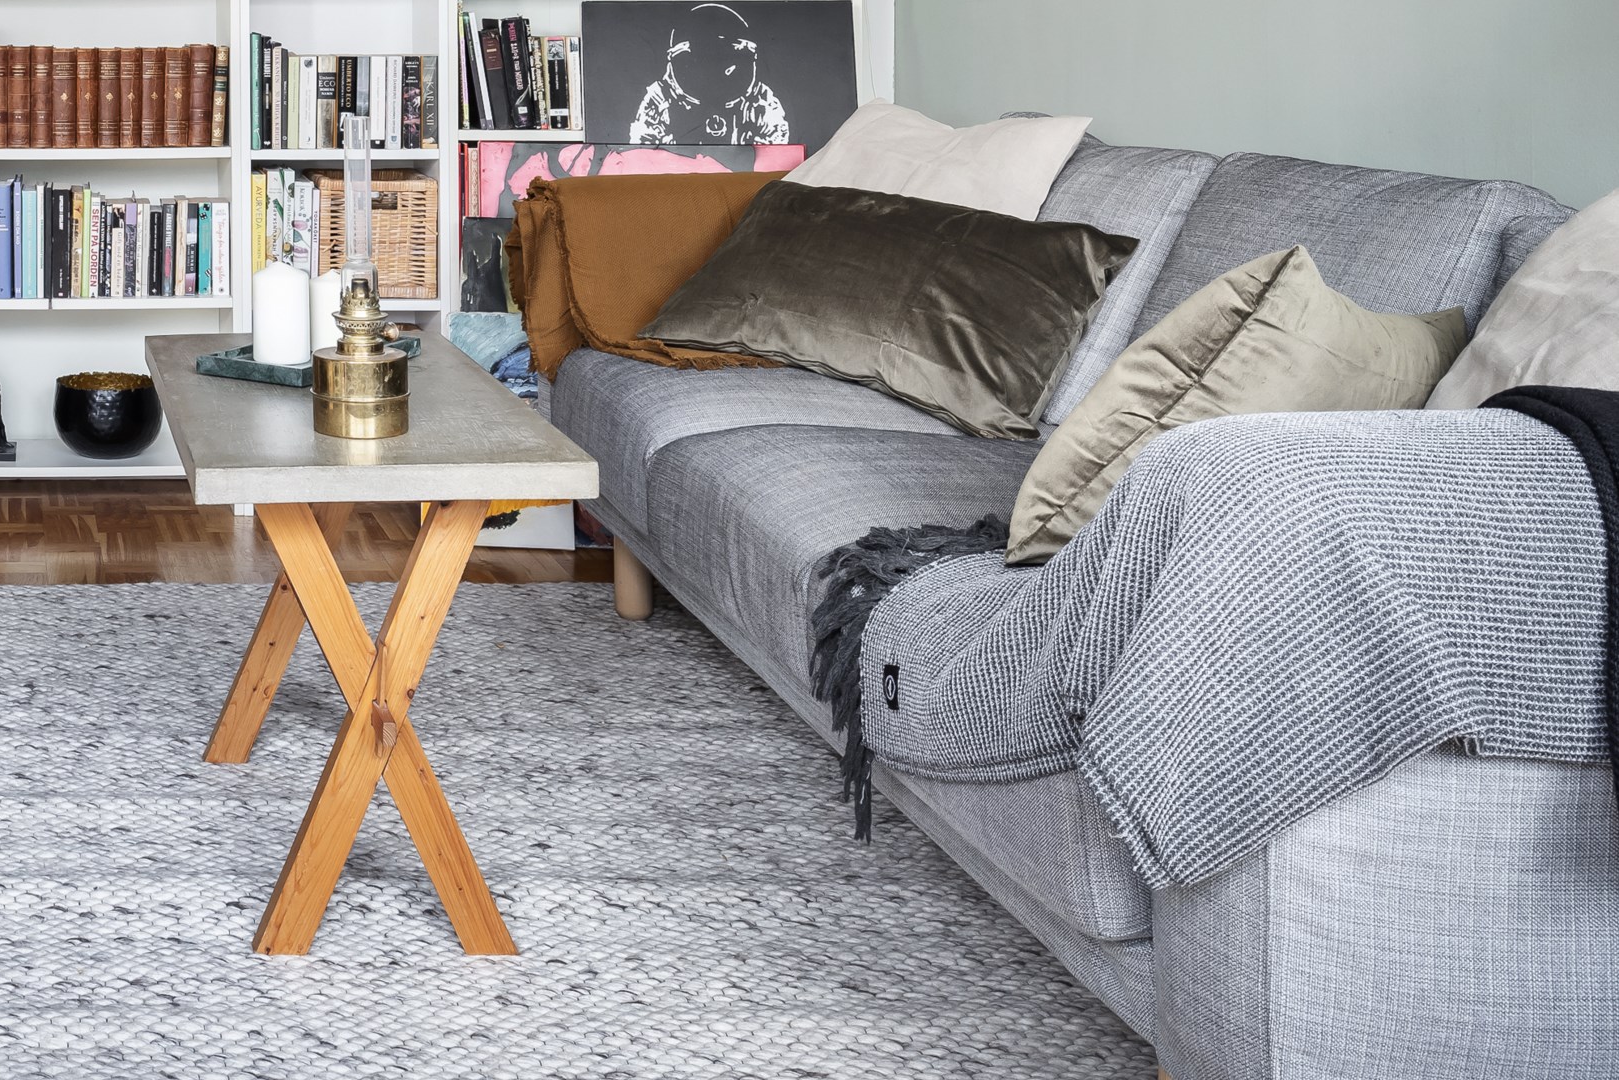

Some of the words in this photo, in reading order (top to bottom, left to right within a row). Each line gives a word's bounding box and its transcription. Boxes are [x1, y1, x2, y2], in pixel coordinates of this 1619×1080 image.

[318, 80, 336, 88] ECO
[426, 81, 435, 109] KARL
[426, 112, 435, 126] XII
[255, 185, 263, 230] AYURVEDA
[91, 208, 100, 234] SENT
[91, 234, 100, 247] PÅ
[90, 248, 98, 287] JORDEN
